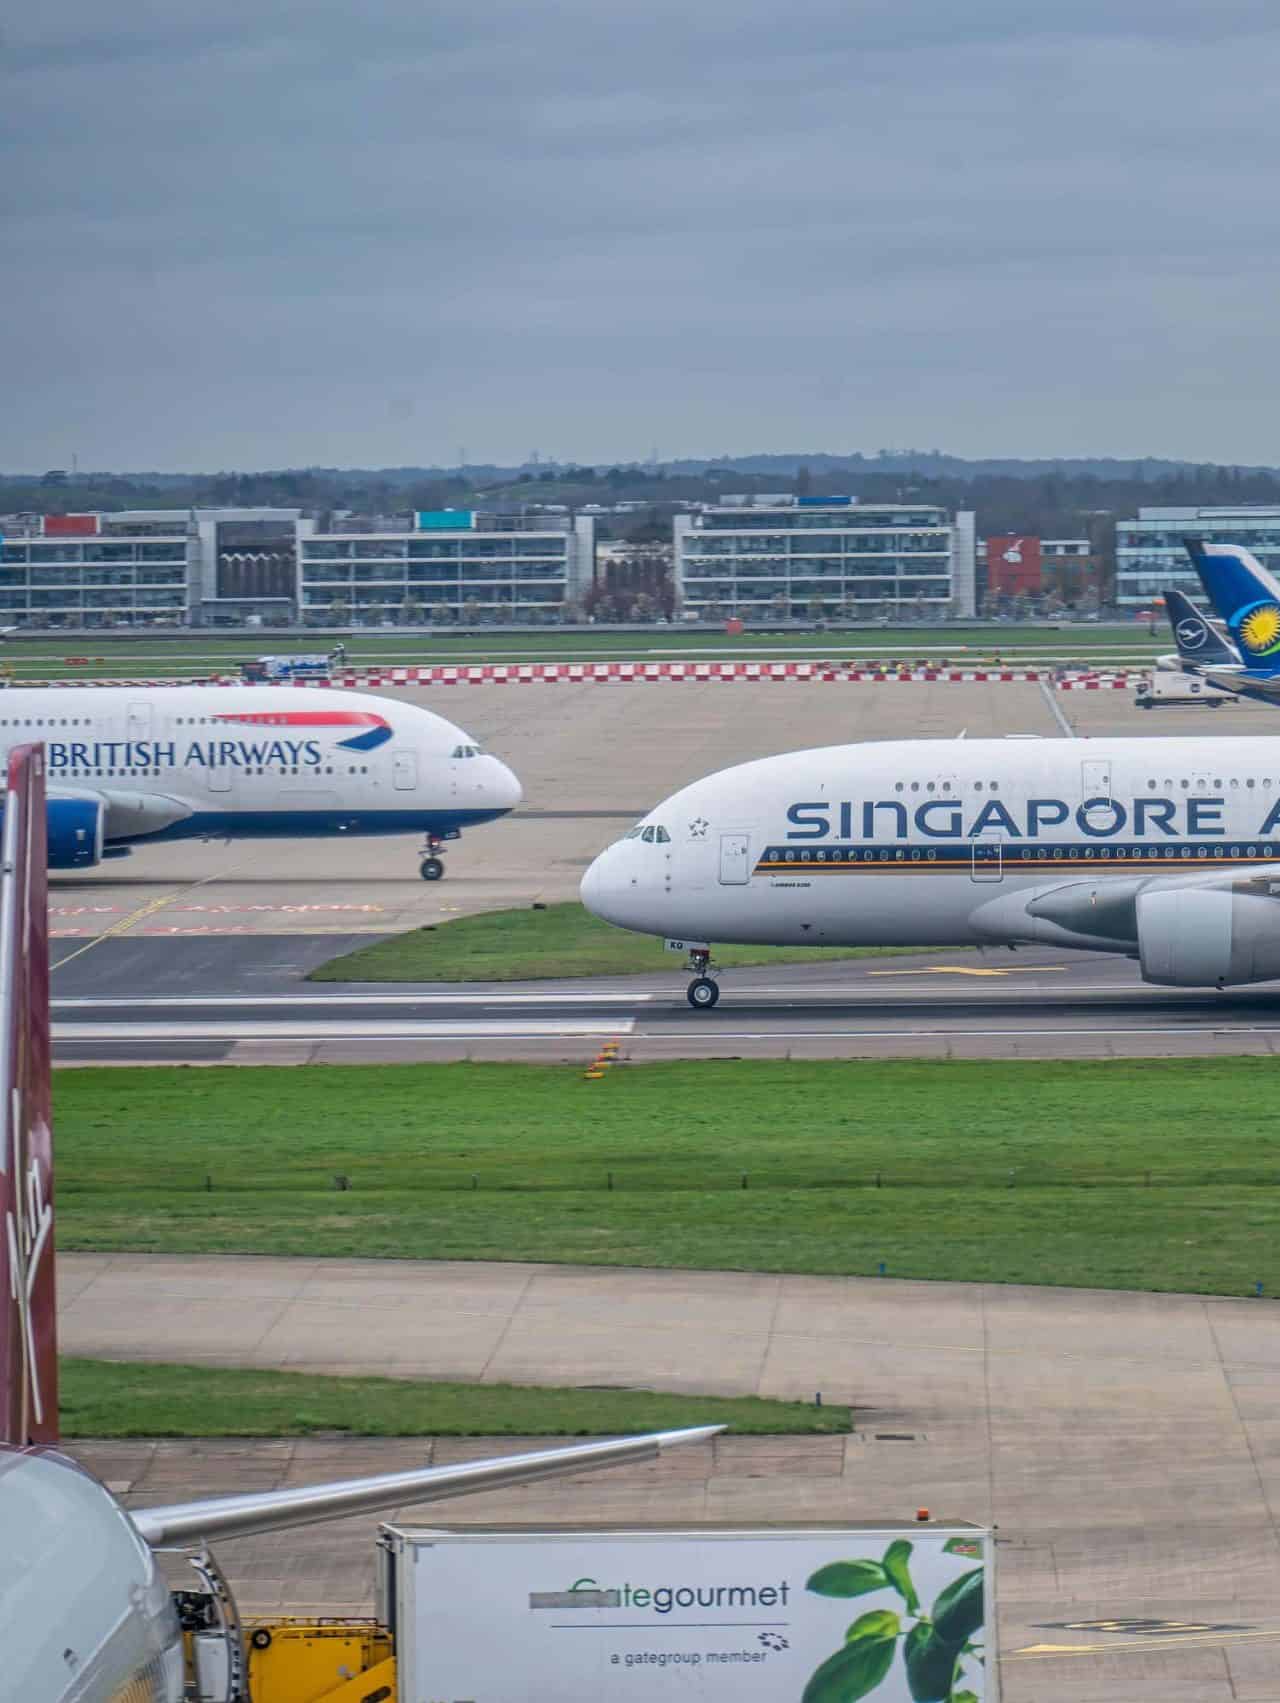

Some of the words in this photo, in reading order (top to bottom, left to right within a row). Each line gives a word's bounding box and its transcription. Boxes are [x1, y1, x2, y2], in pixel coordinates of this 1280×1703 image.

[48, 742, 176, 767] BRITISH
[184, 740, 321, 767] AIRWAYS
[786, 797, 1226, 839] SINGAPORE
[610, 1653, 620, 1663] a
[624, 1652, 701, 1667] gategroup
[706, 1650, 767, 1663] member
